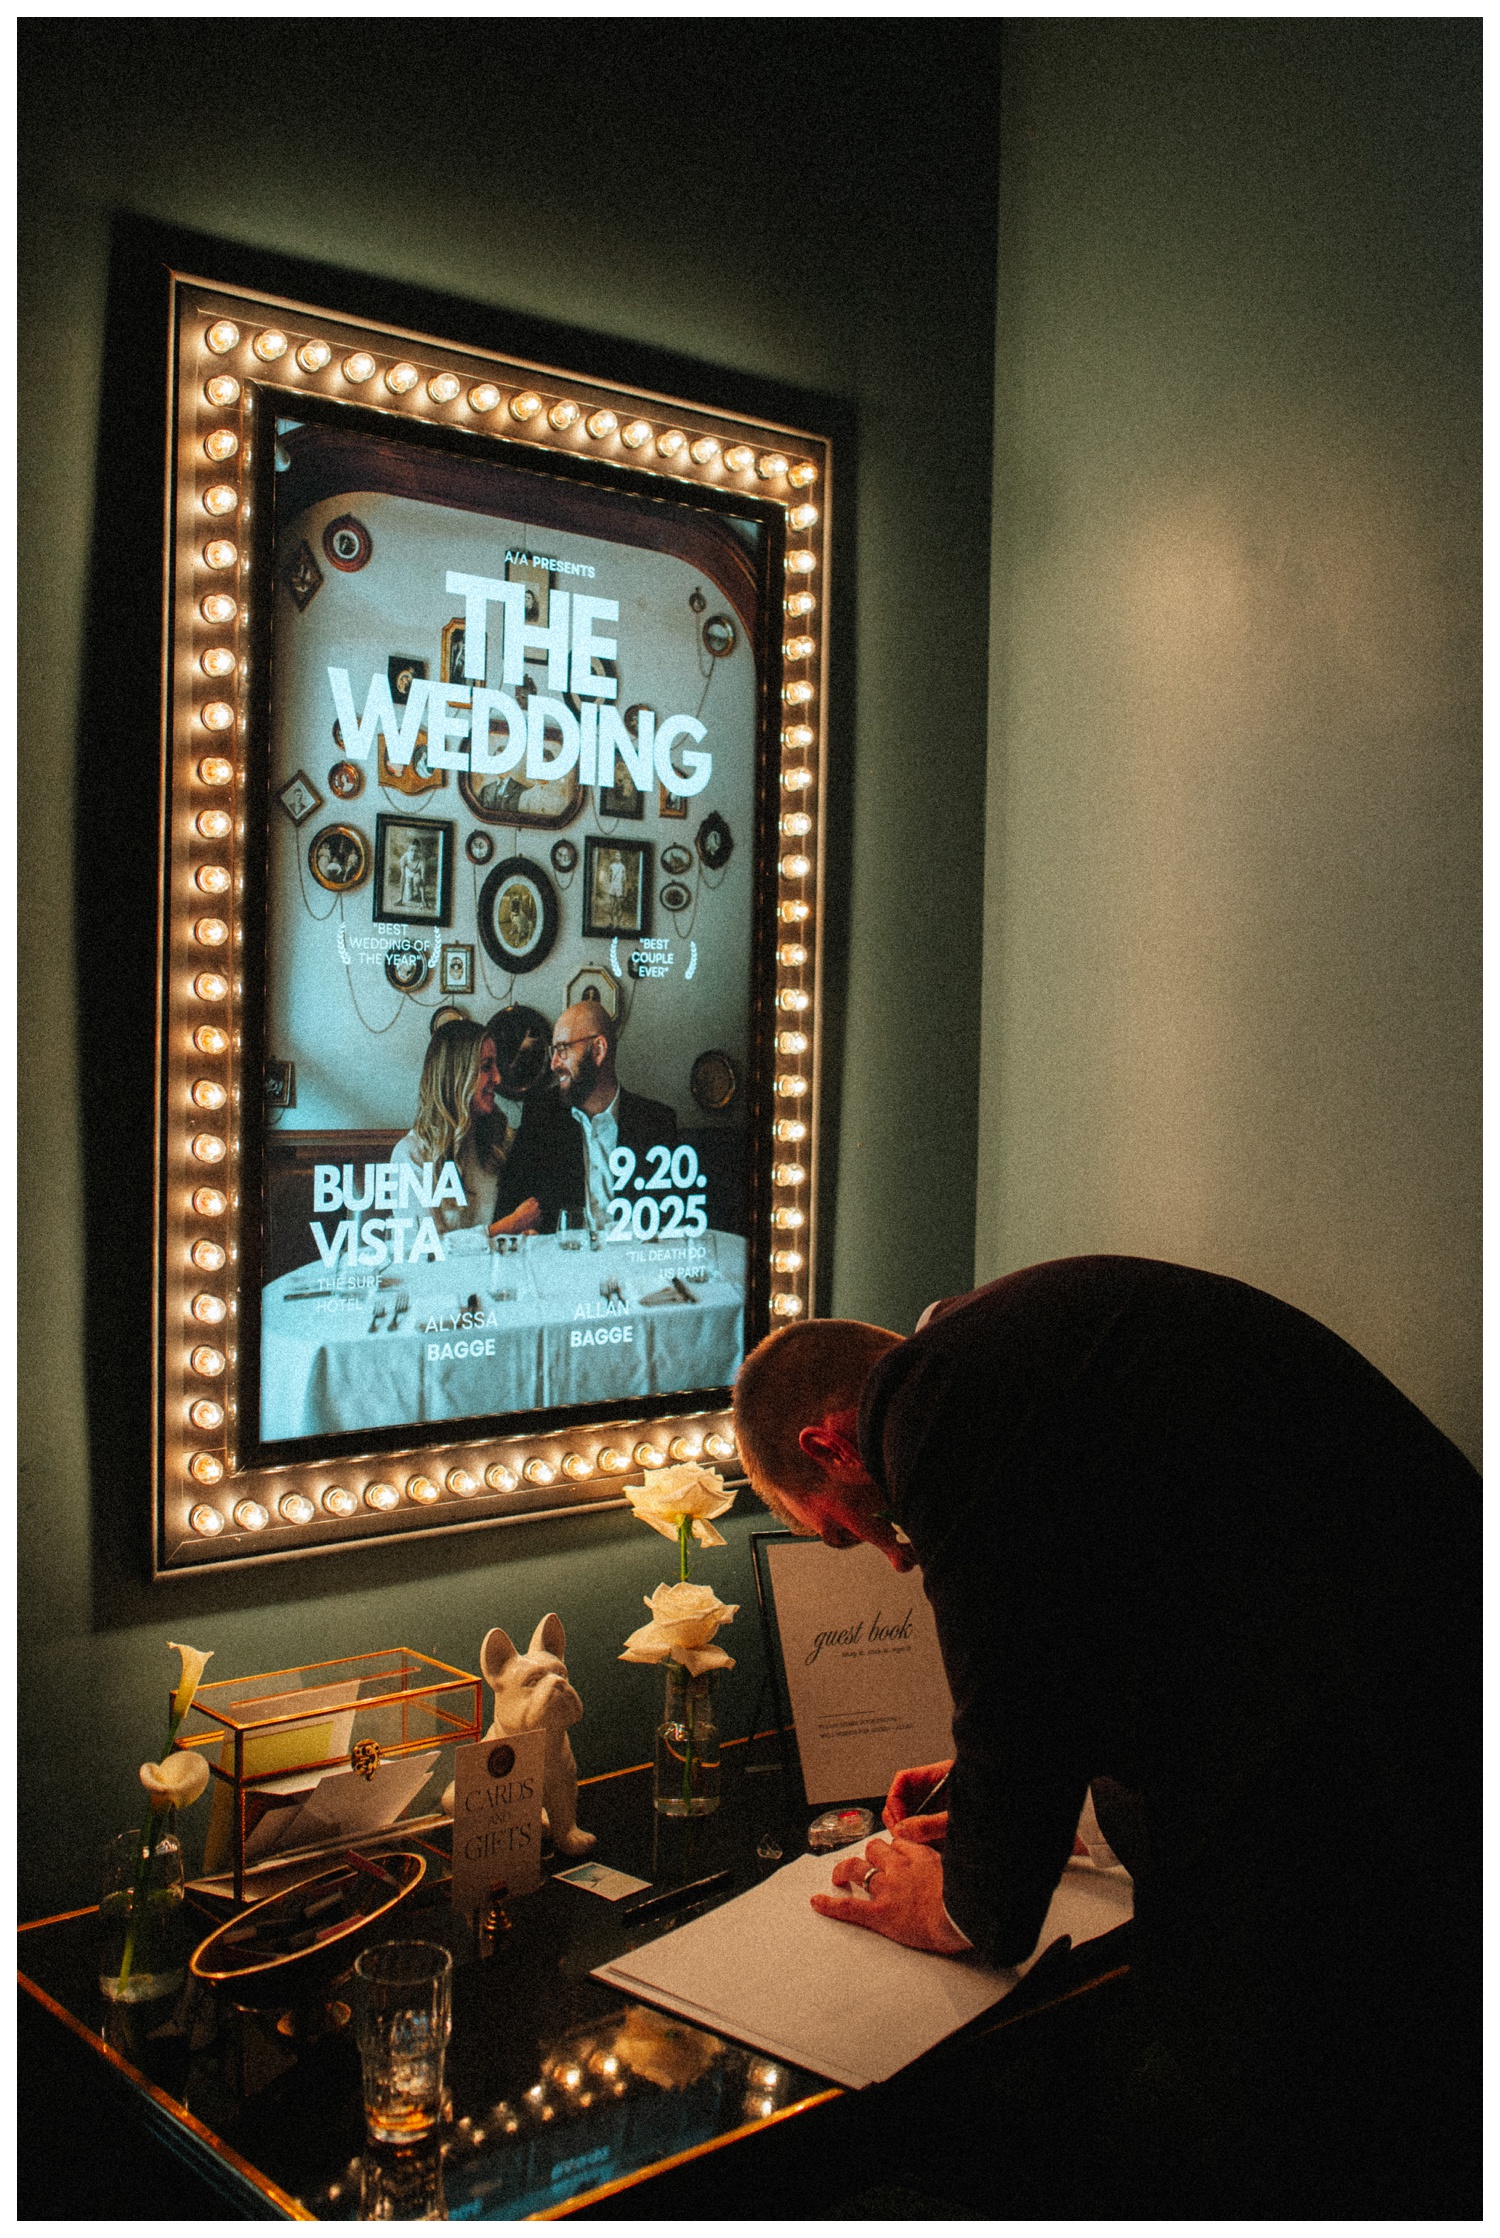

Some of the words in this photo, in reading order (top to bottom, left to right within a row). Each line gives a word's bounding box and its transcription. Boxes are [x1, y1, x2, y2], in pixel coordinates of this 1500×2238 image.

[504, 550, 529, 566] A/A
[532, 556, 596, 579] PRESENTS
[446, 570, 619, 699] THE
[327, 666, 713, 797] WEDDING
[373, 923, 408, 935] "BEST
[349, 937, 411, 951] WEDDING
[413, 938, 431, 952] OF
[639, 938, 669, 950] "BEST
[359, 952, 384, 965] THE
[385, 953, 421, 967] YEAR"
[631, 951, 674, 965] COUPLE
[638, 965, 669, 978] EVER"
[608, 1144, 707, 1191] 9.20.
[313, 1160, 468, 1213] BUENA
[606, 1194, 708, 1242] 2025
[309, 1216, 446, 1268] VISTA
[648, 1248, 687, 1262] DEATH
[688, 1246, 707, 1260] DO
[317, 1277, 345, 1291] THE
[348, 1275, 383, 1290] SURF
[659, 1267, 675, 1280] US
[676, 1265, 706, 1279] PART
[317, 1298, 363, 1313] HOTEL
[573, 1299, 630, 1320] ALLAN
[424, 1311, 498, 1333] ALYSSA
[570, 1325, 633, 1348] BAGGE
[427, 1338, 496, 1362] BAGGE
[804, 1620, 864, 1667] guest
[867, 1608, 913, 1643] book
[465, 1778, 534, 1813] CARDS
[464, 1823, 531, 1861] GIFTS
